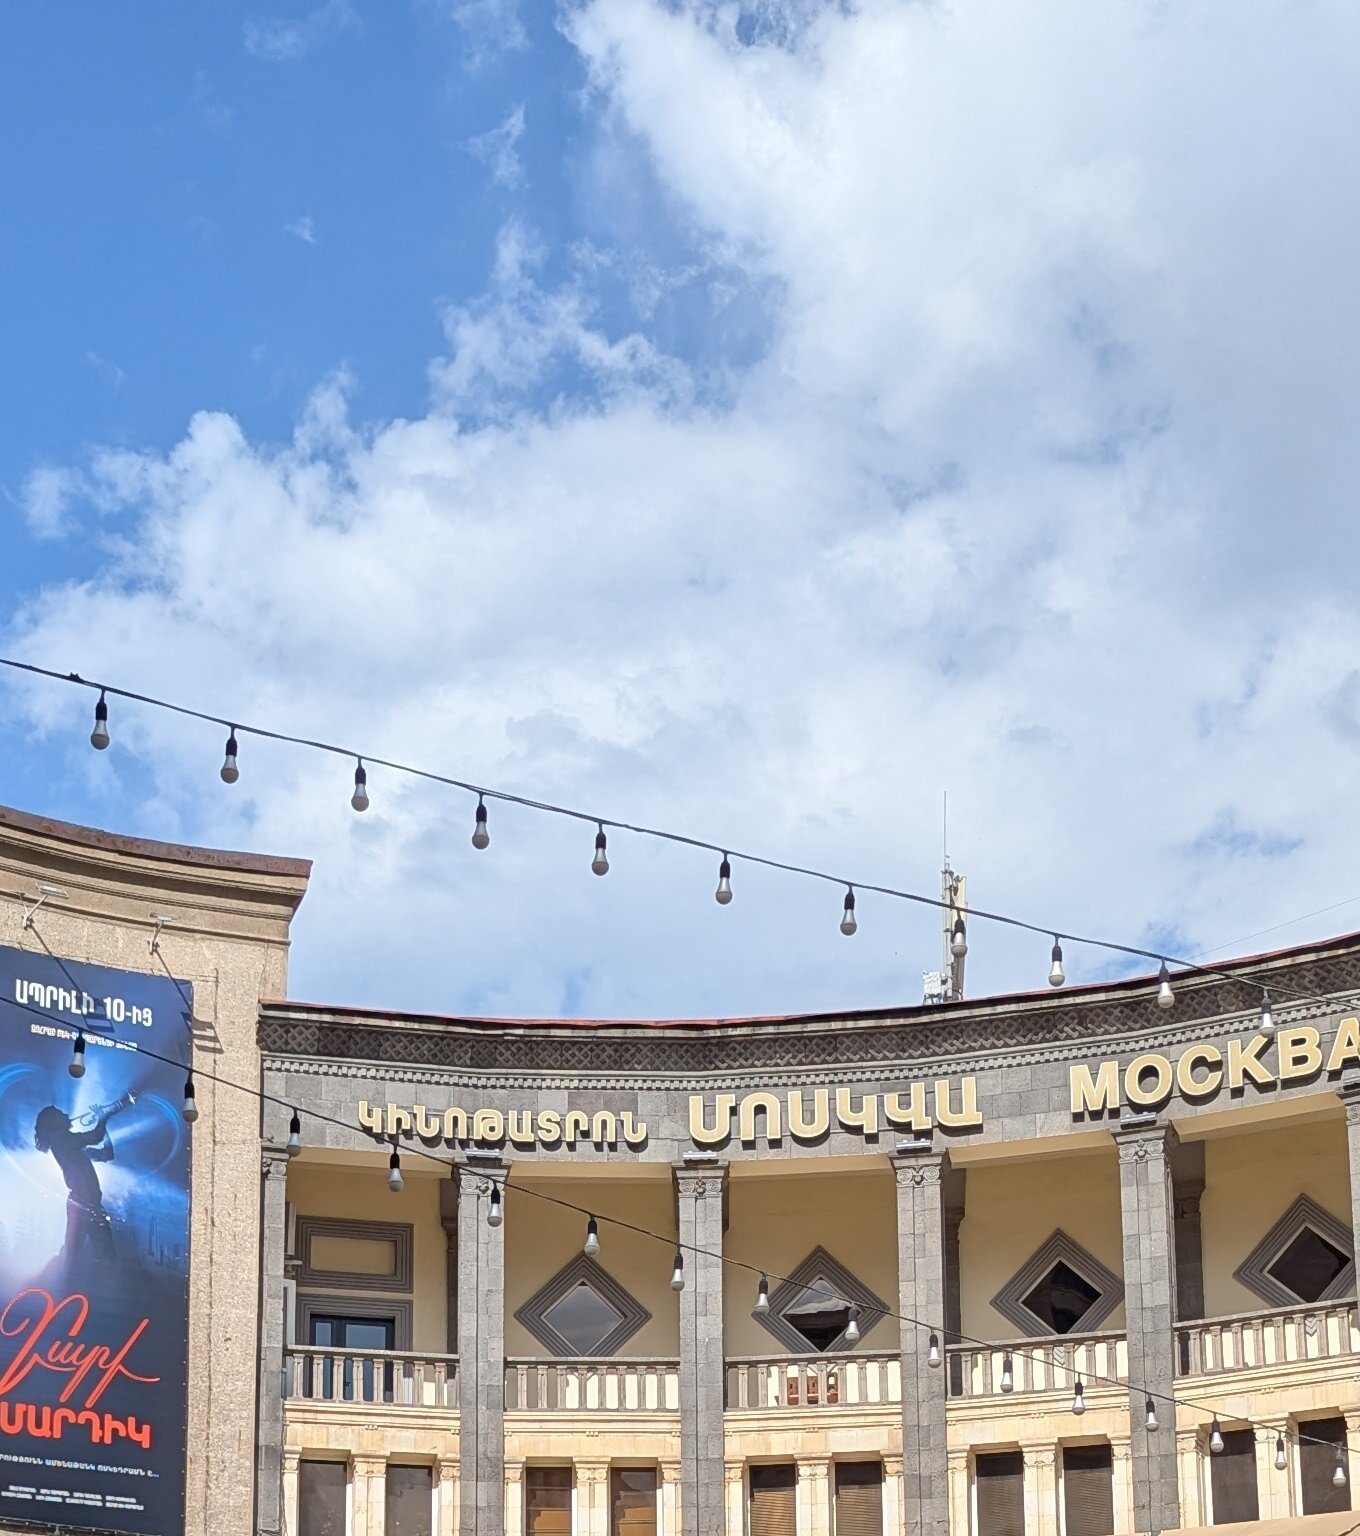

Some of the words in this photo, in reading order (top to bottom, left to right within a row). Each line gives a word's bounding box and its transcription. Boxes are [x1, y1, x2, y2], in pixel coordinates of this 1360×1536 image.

[15, 978, 95, 1014] ԱՊՐԻԼԻ
[357, 1100, 648, 1145] ԿԻՆՈԹԱՏՐՈՆ
[687, 1075, 984, 1144] ՄՈՍԿՎԱ
